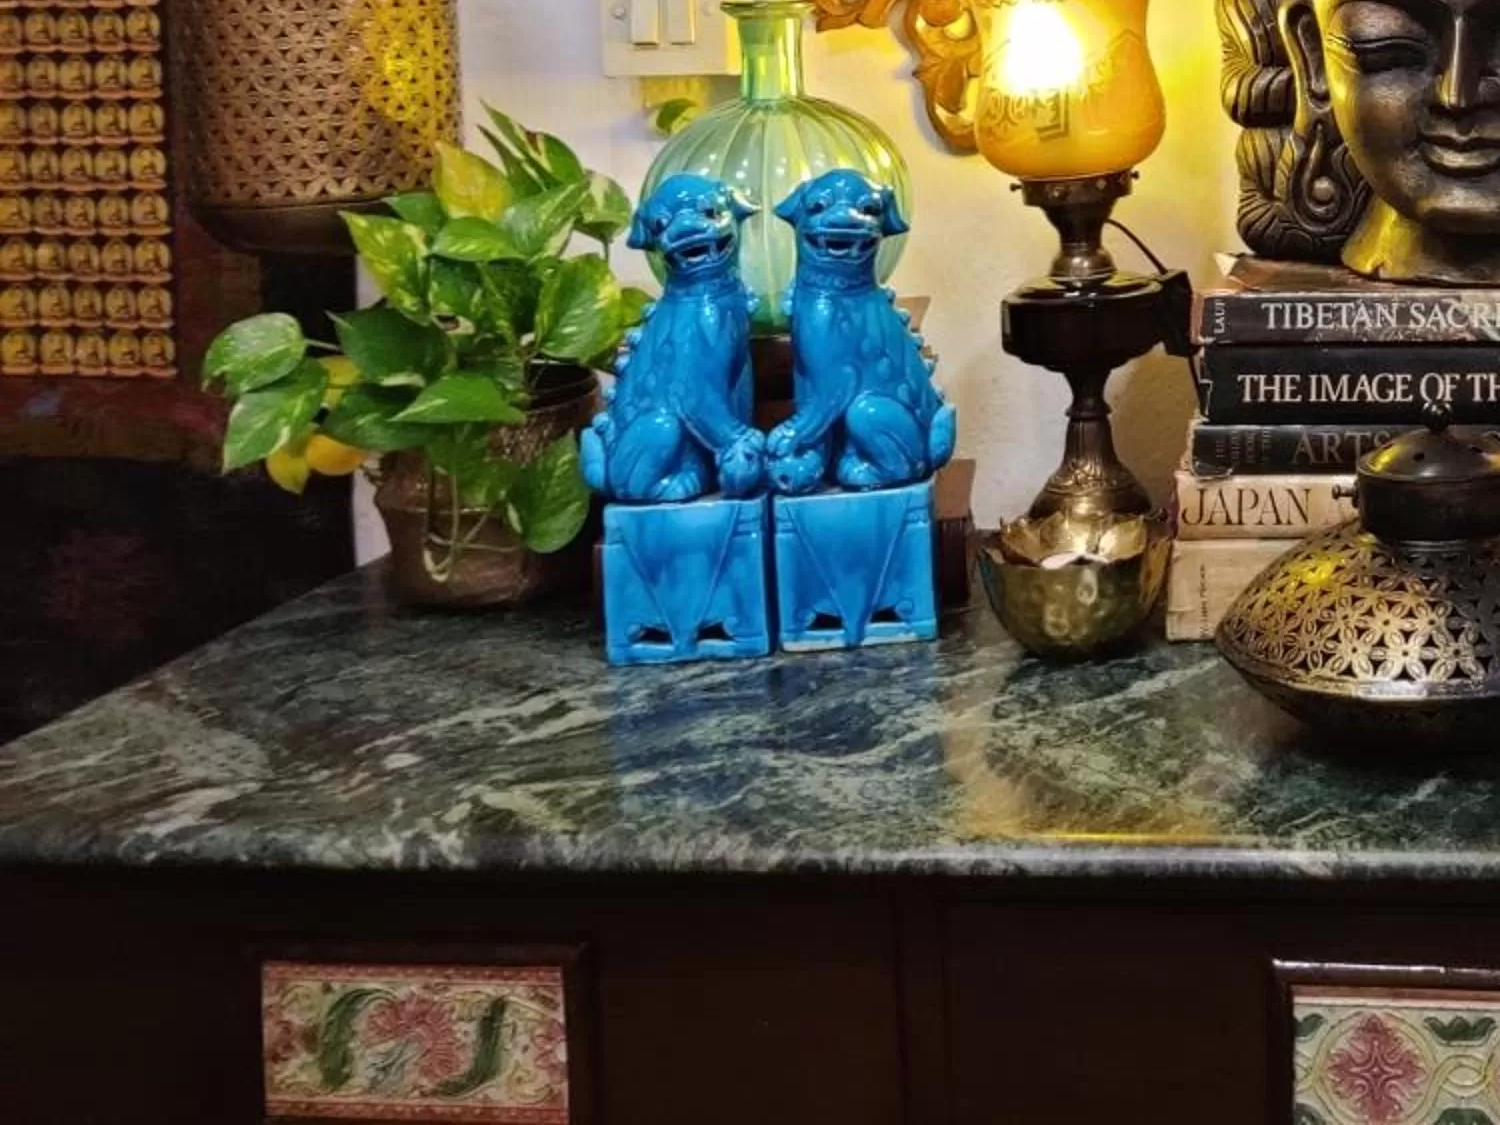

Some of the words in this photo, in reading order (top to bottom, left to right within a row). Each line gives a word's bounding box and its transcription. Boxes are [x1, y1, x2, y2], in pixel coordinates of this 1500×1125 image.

[1261, 302, 1397, 329] TIBETAN
[1237, 374, 1301, 403] THE
[1309, 372, 1413, 403] IMAGE
[1419, 372, 1461, 403] OF
[1181, 488, 1312, 526] JAPAN
